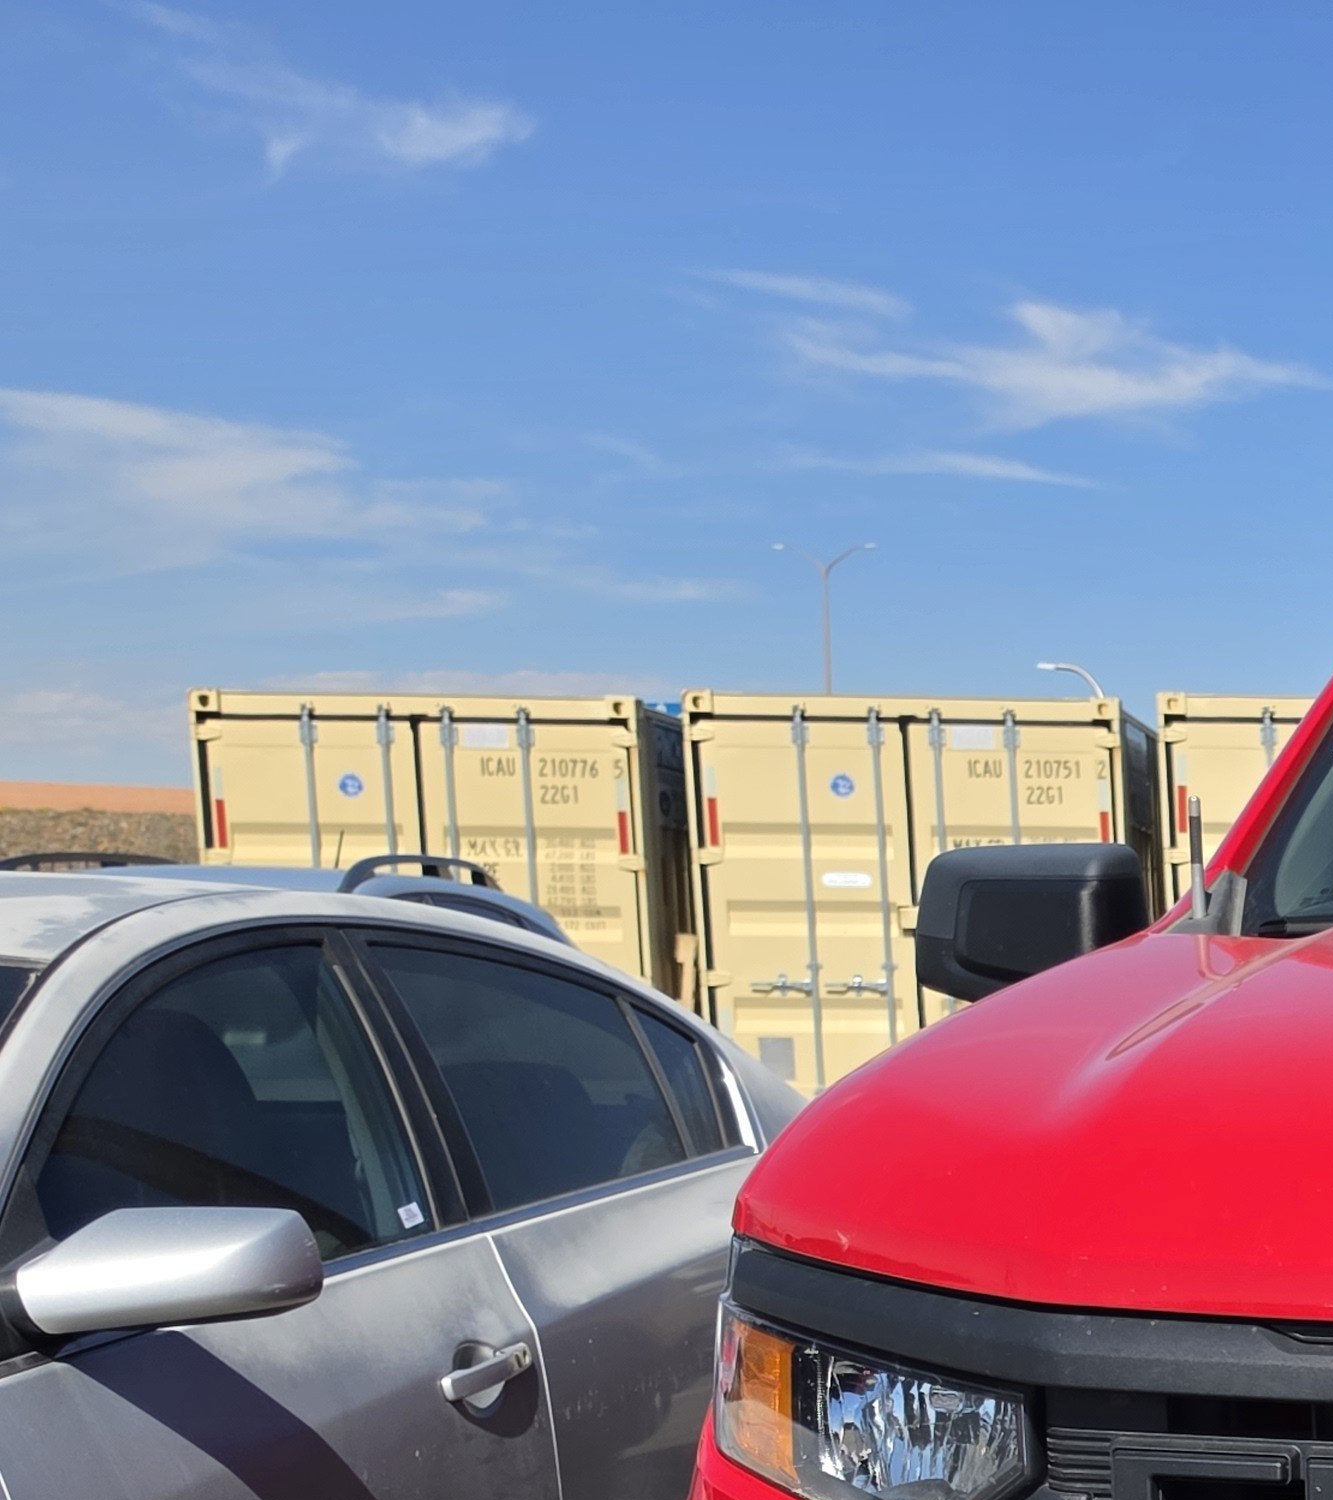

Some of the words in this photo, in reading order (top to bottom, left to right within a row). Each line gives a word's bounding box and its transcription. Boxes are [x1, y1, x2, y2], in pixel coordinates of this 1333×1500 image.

[480, 756, 516, 777] ICAU
[538, 757, 599, 779] 210776
[613, 759, 625, 779] 5
[967, 758, 1002, 779] ICAU
[1024, 758, 1081, 780] 210751
[1096, 759, 1107, 780] 2
[540, 785, 580, 805] 22G1
[1026, 785, 1064, 805] 22G1
